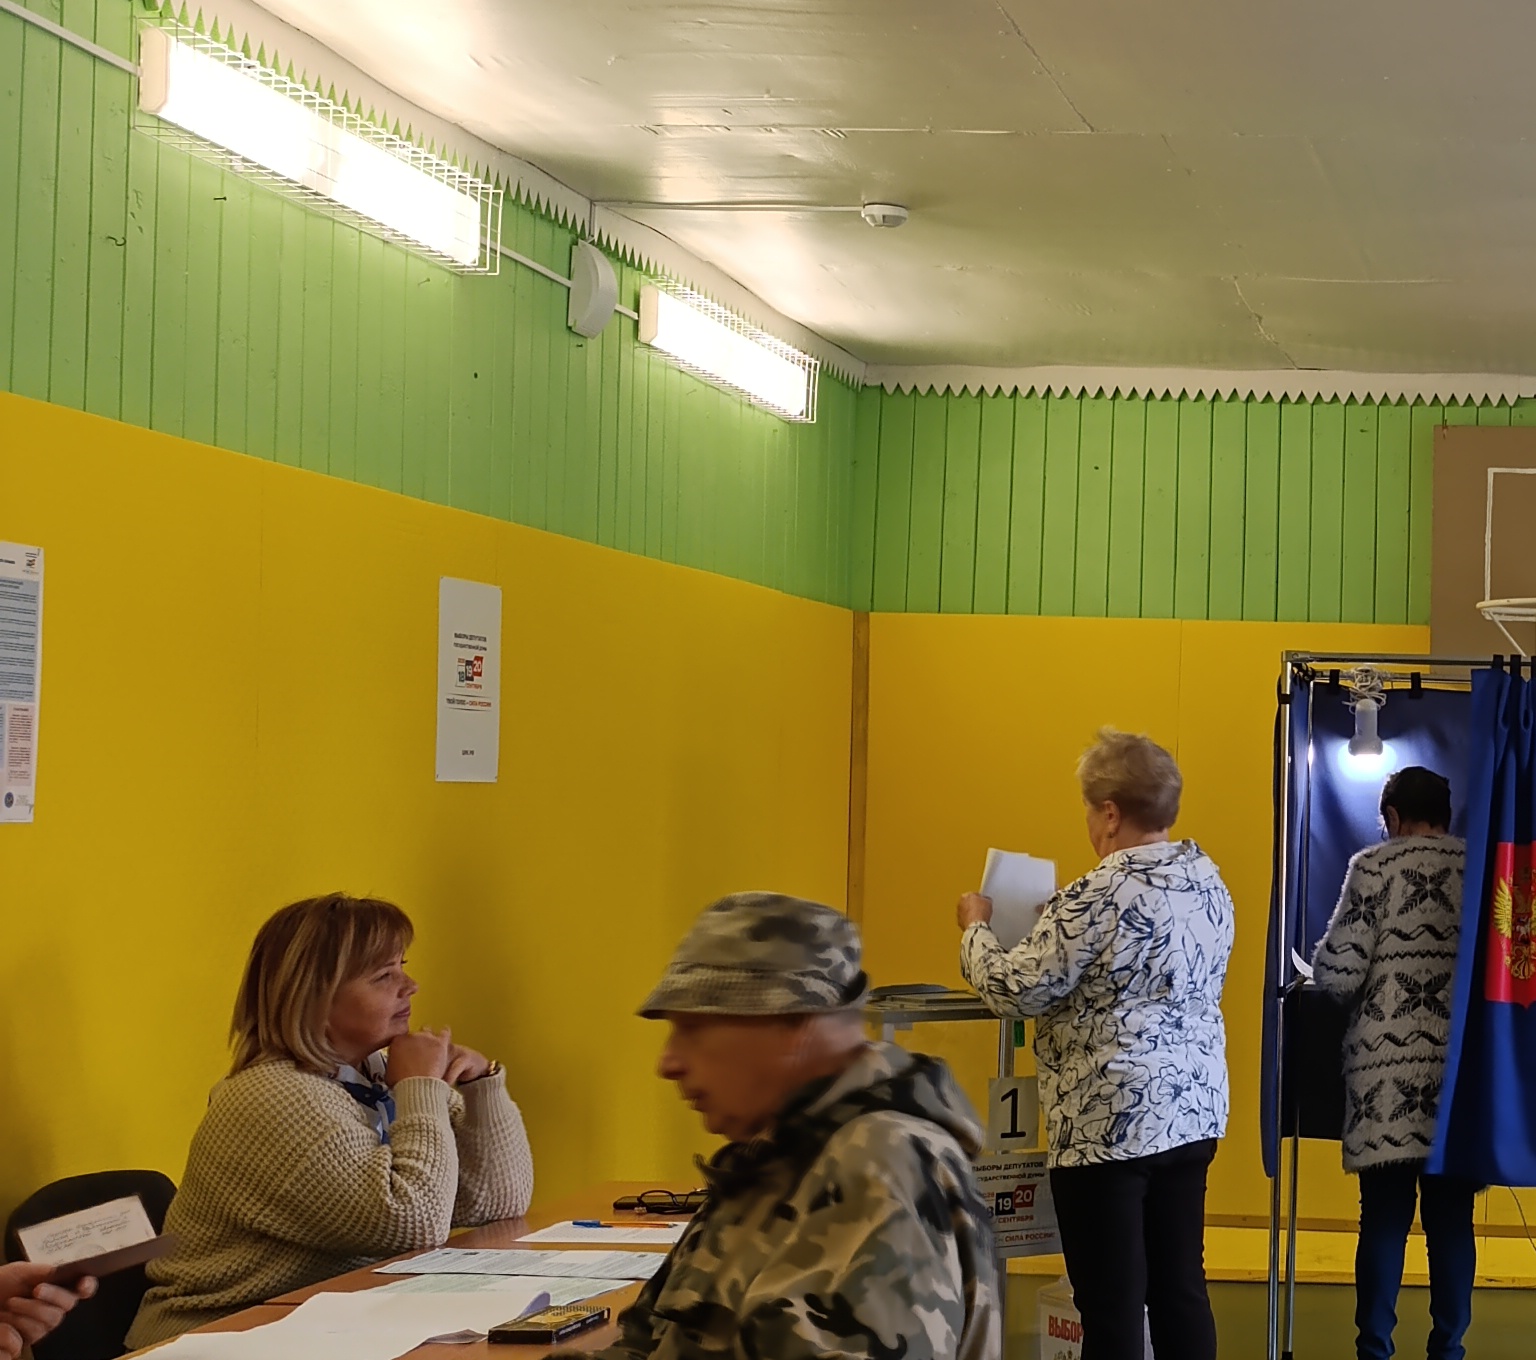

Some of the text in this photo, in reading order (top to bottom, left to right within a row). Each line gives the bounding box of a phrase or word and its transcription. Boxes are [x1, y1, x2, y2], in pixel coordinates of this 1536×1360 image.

[473, 660, 482, 672] 20
[1000, 1087, 1027, 1139] 1
[1003, 1161, 1044, 1171] ДЕПУТАТОВ
[997, 1197, 1012, 1211] 19
[1014, 1189, 1033, 1203] 20
[998, 1214, 1034, 1224] СЕНТЯБРЯ
[1048, 1314, 1084, 1344] ВЫБОР
